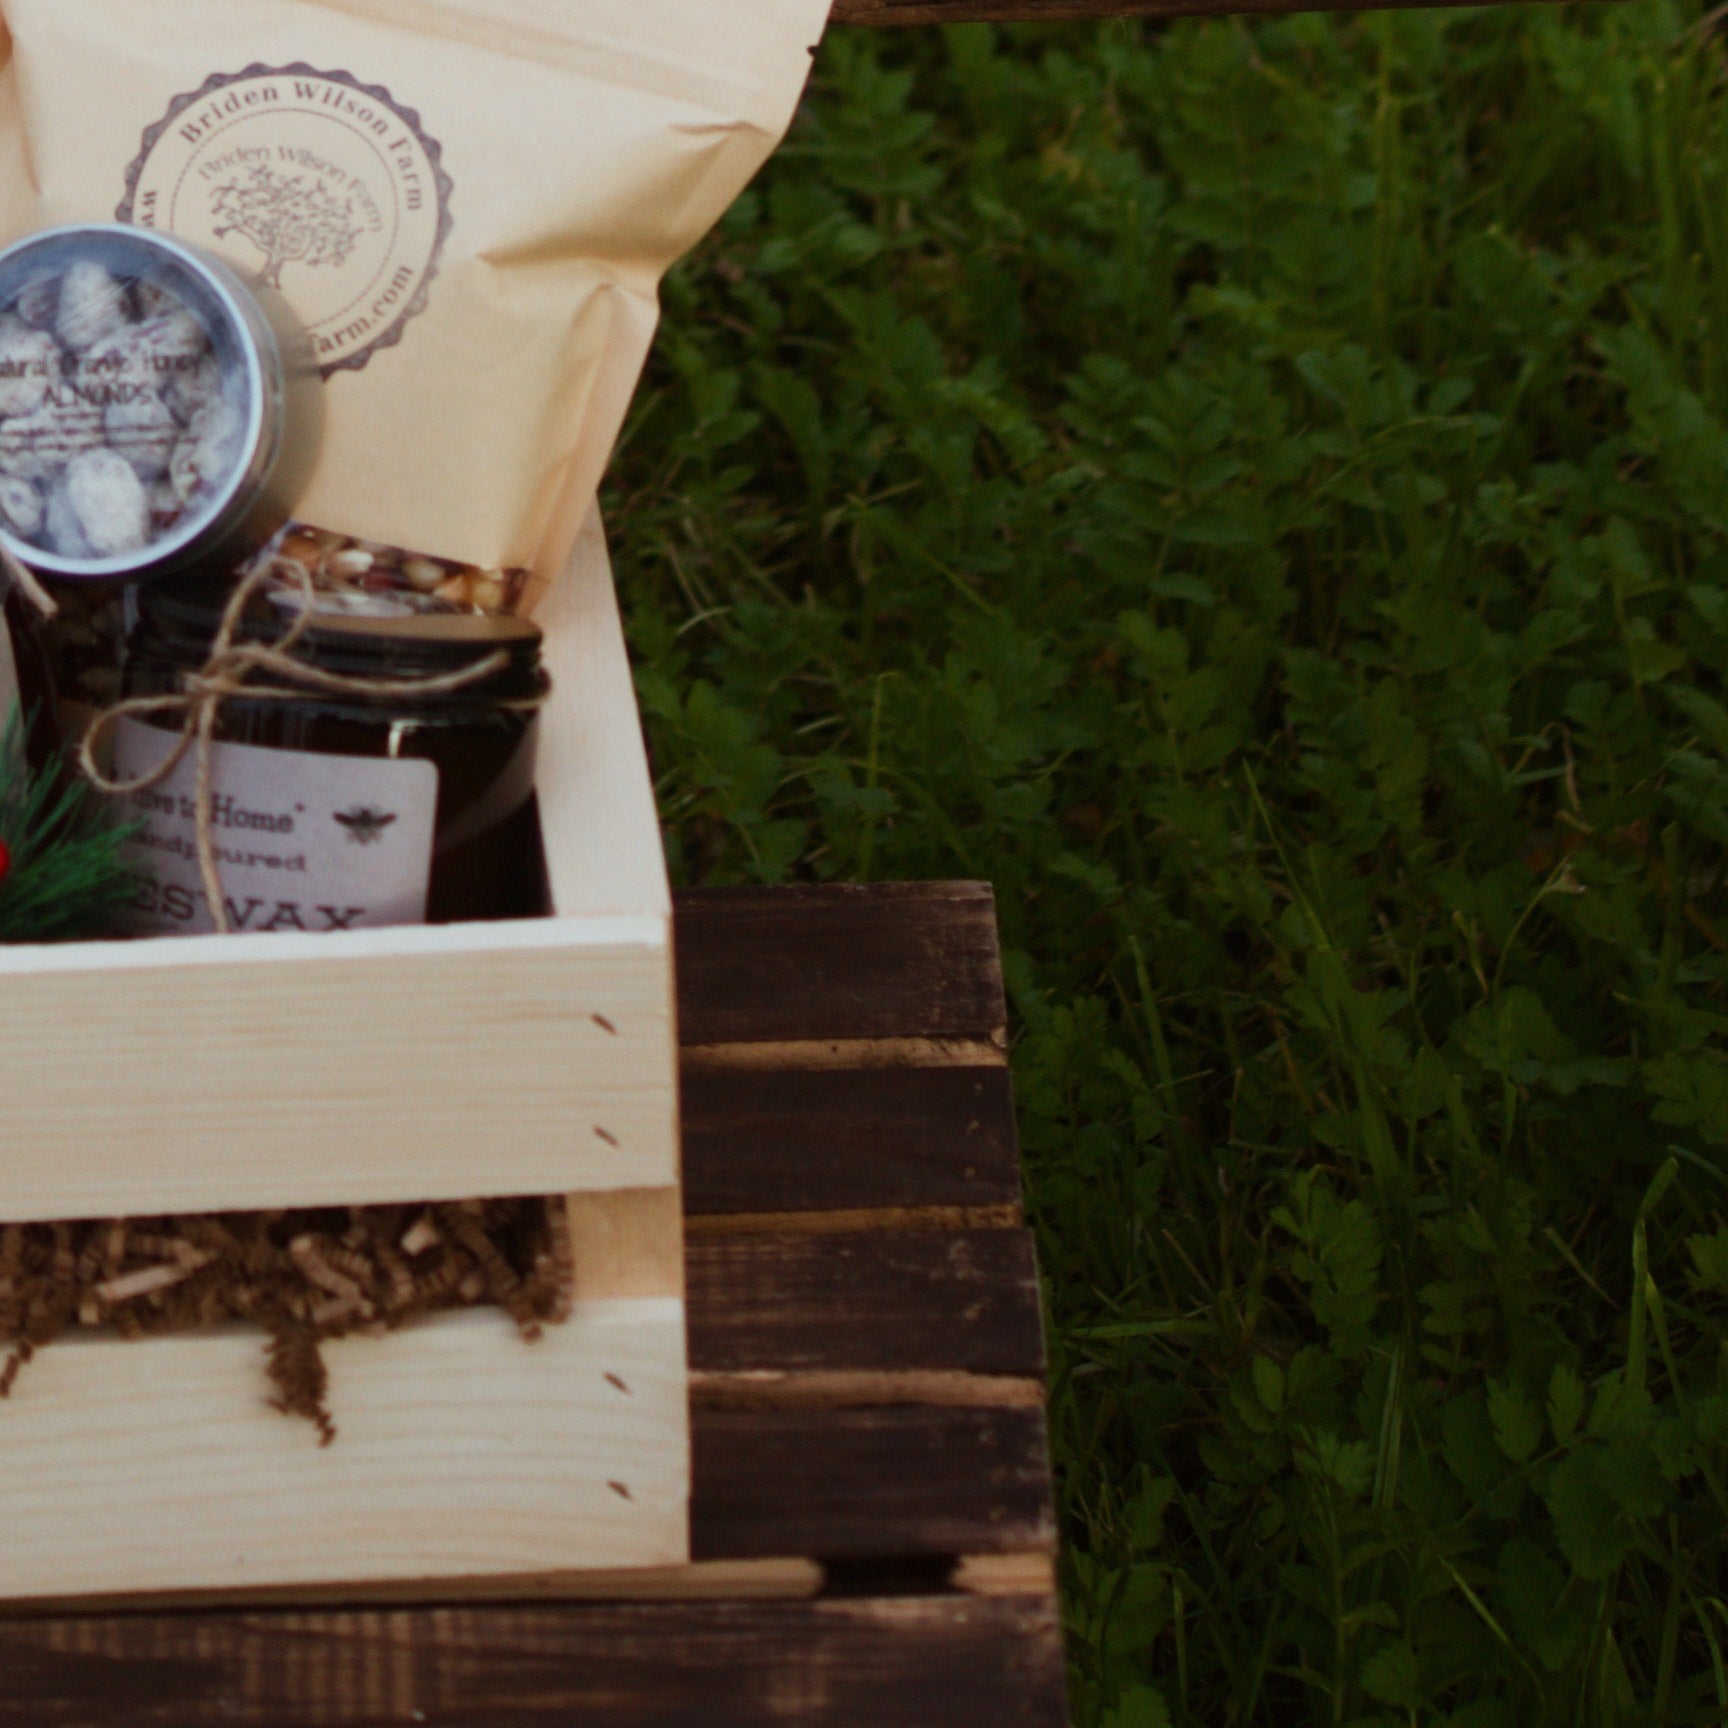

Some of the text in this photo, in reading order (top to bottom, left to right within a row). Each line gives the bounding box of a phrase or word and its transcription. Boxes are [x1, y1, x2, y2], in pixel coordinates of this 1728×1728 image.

[177, 80, 424, 212] Briden Wilson Farm
[197, 144, 384, 234] Briden Wilson Farm
[42, 382, 153, 410] ALMONDS
